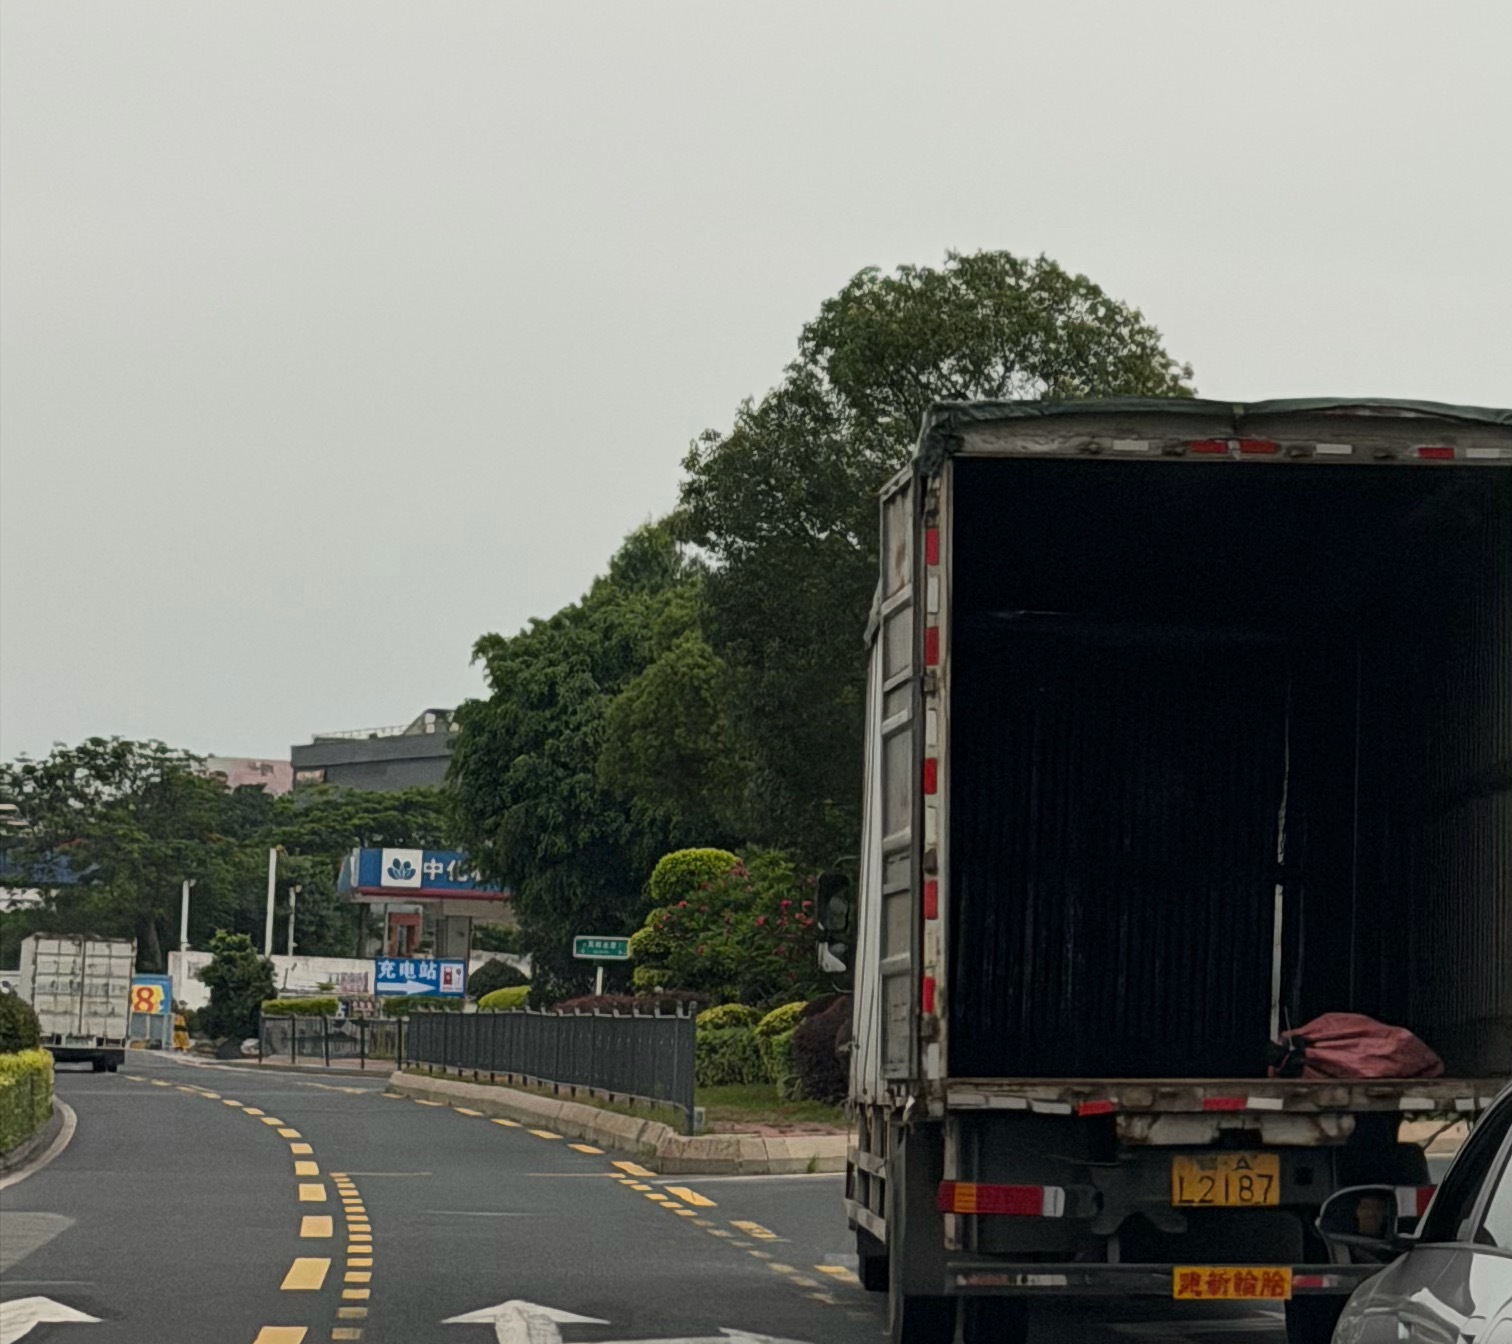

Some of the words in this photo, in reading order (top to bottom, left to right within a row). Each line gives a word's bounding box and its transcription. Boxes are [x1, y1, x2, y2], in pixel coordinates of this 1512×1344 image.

[377, 960, 438, 981] 充电站
[1178, 1173, 1275, 1204] L2187
